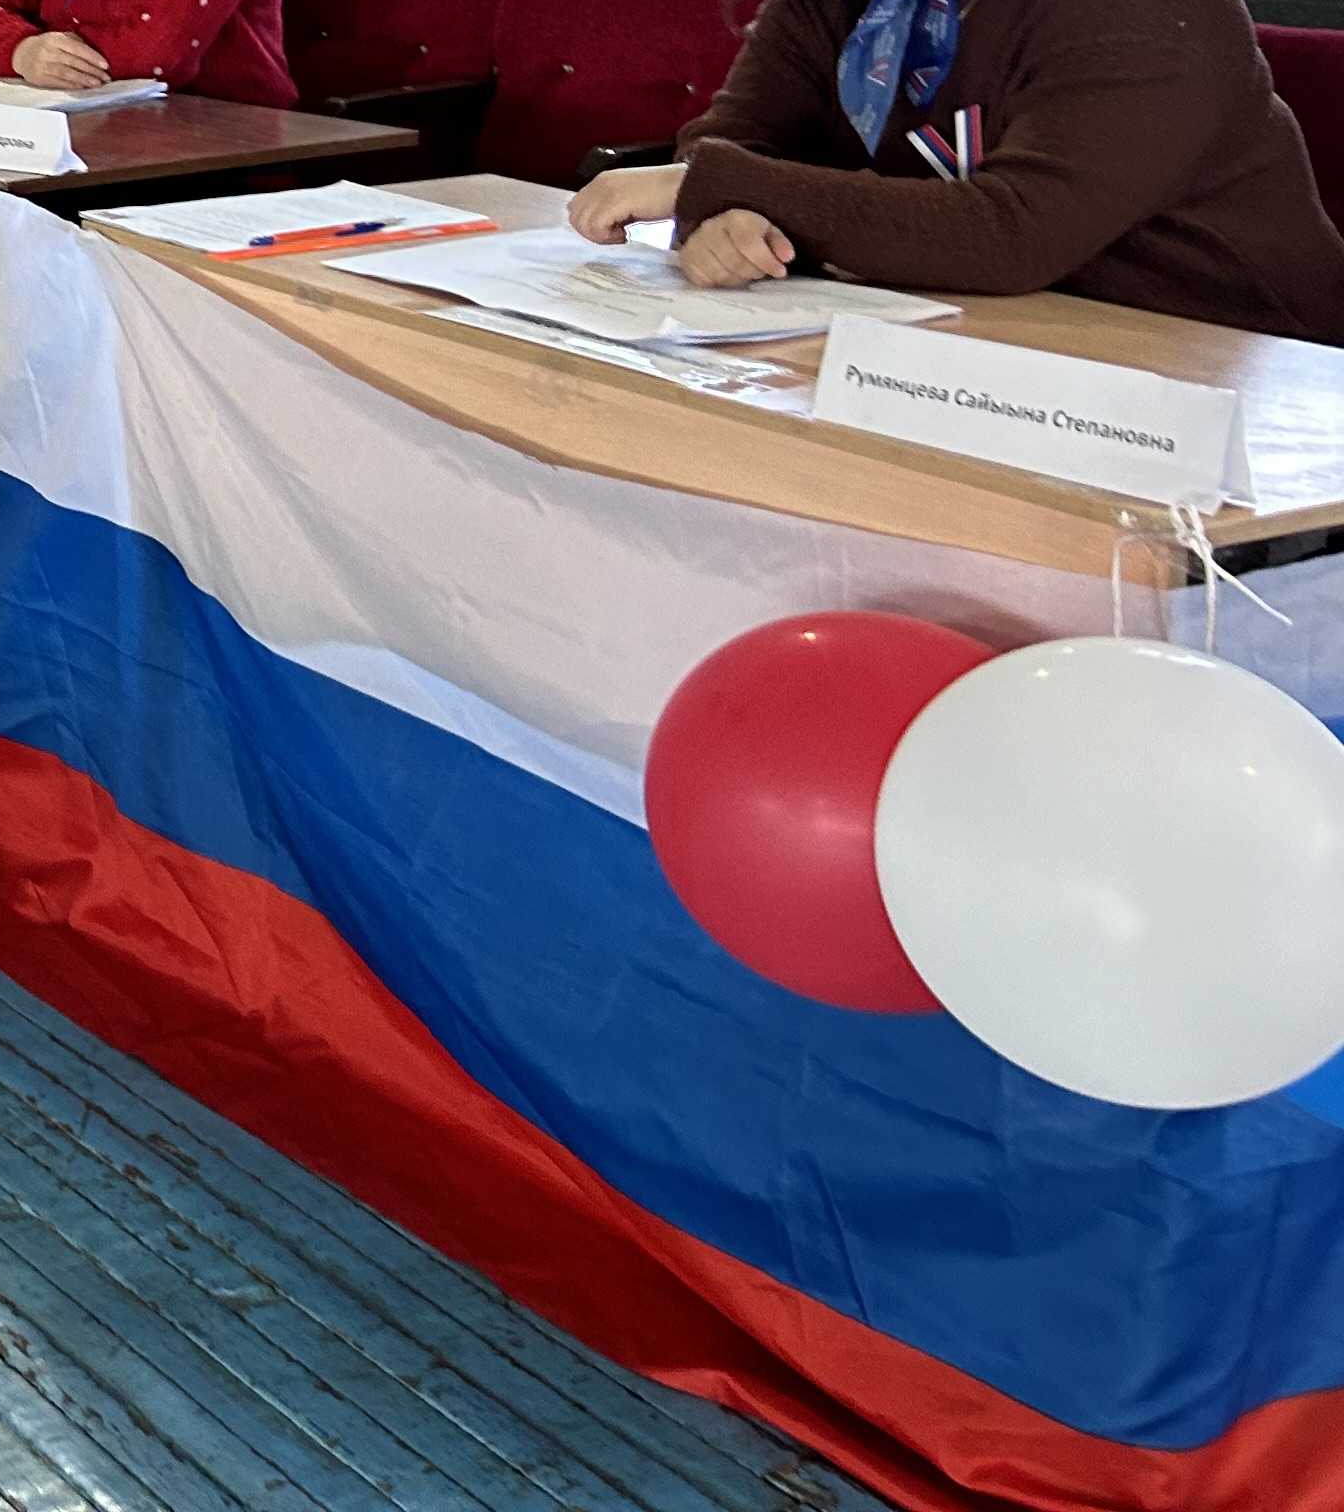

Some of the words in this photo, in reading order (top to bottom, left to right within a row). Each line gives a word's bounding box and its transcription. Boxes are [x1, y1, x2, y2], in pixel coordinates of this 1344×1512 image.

[845, 364, 949, 402] Румянцева
[954, 388, 1047, 424] Сайыына
[1052, 410, 1176, 454] Степановна
